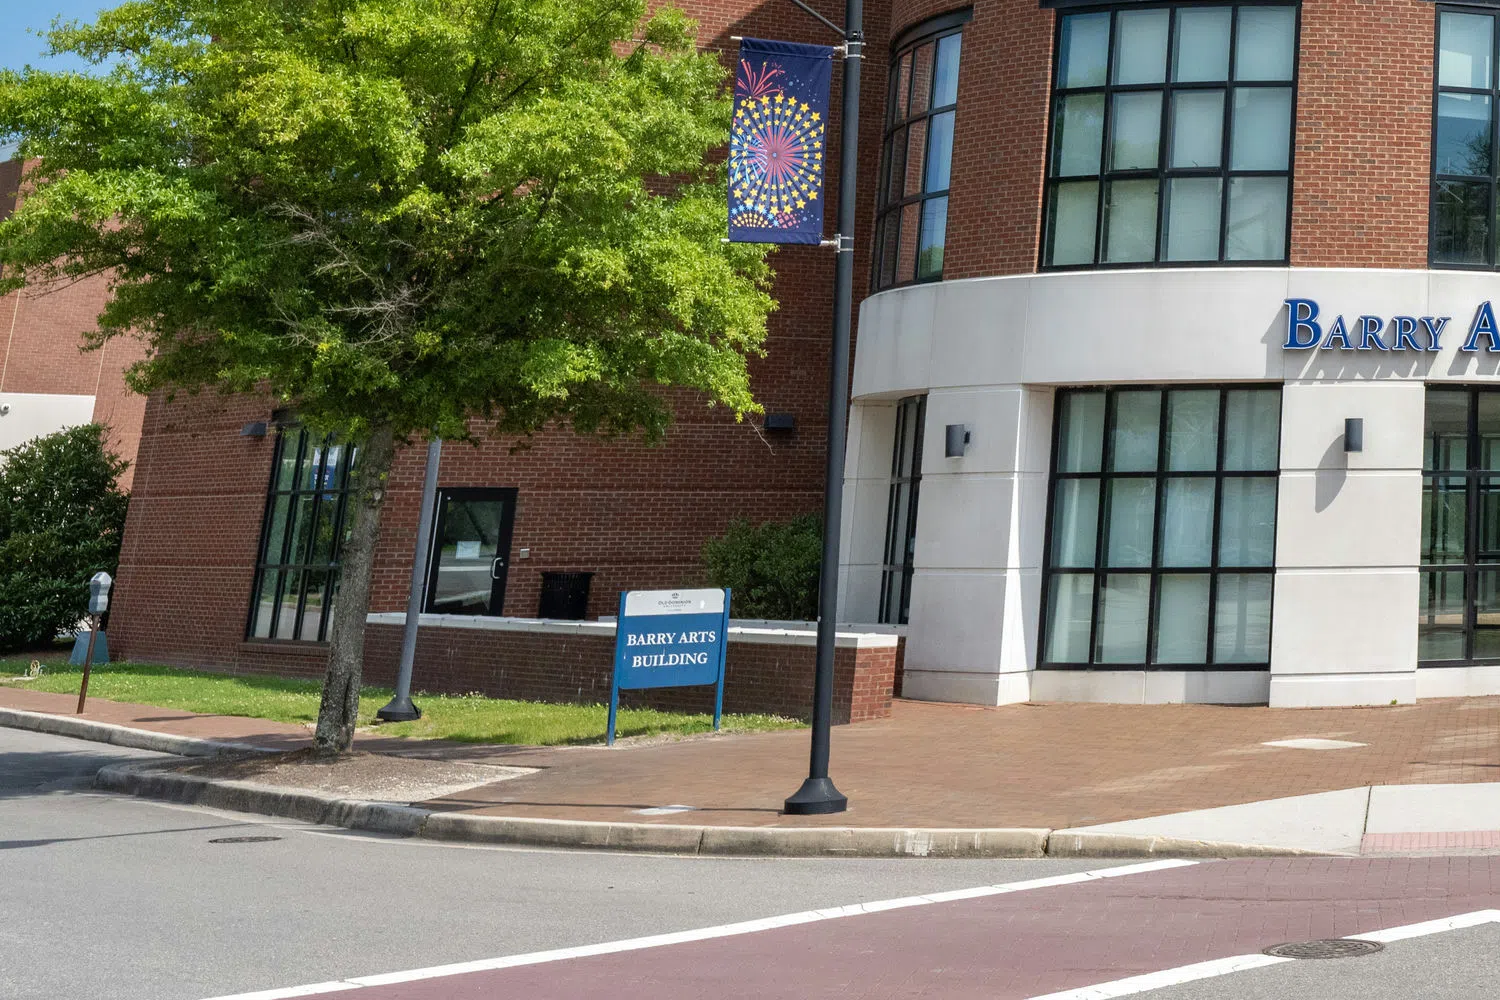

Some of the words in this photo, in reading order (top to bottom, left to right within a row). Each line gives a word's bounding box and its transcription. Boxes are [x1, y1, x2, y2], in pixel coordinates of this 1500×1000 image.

[1282, 297, 1452, 352] BARRY
[626, 632, 676, 647] BARRY
[678, 630, 716, 644] ARTS
[632, 652, 708, 668] BUILDING
